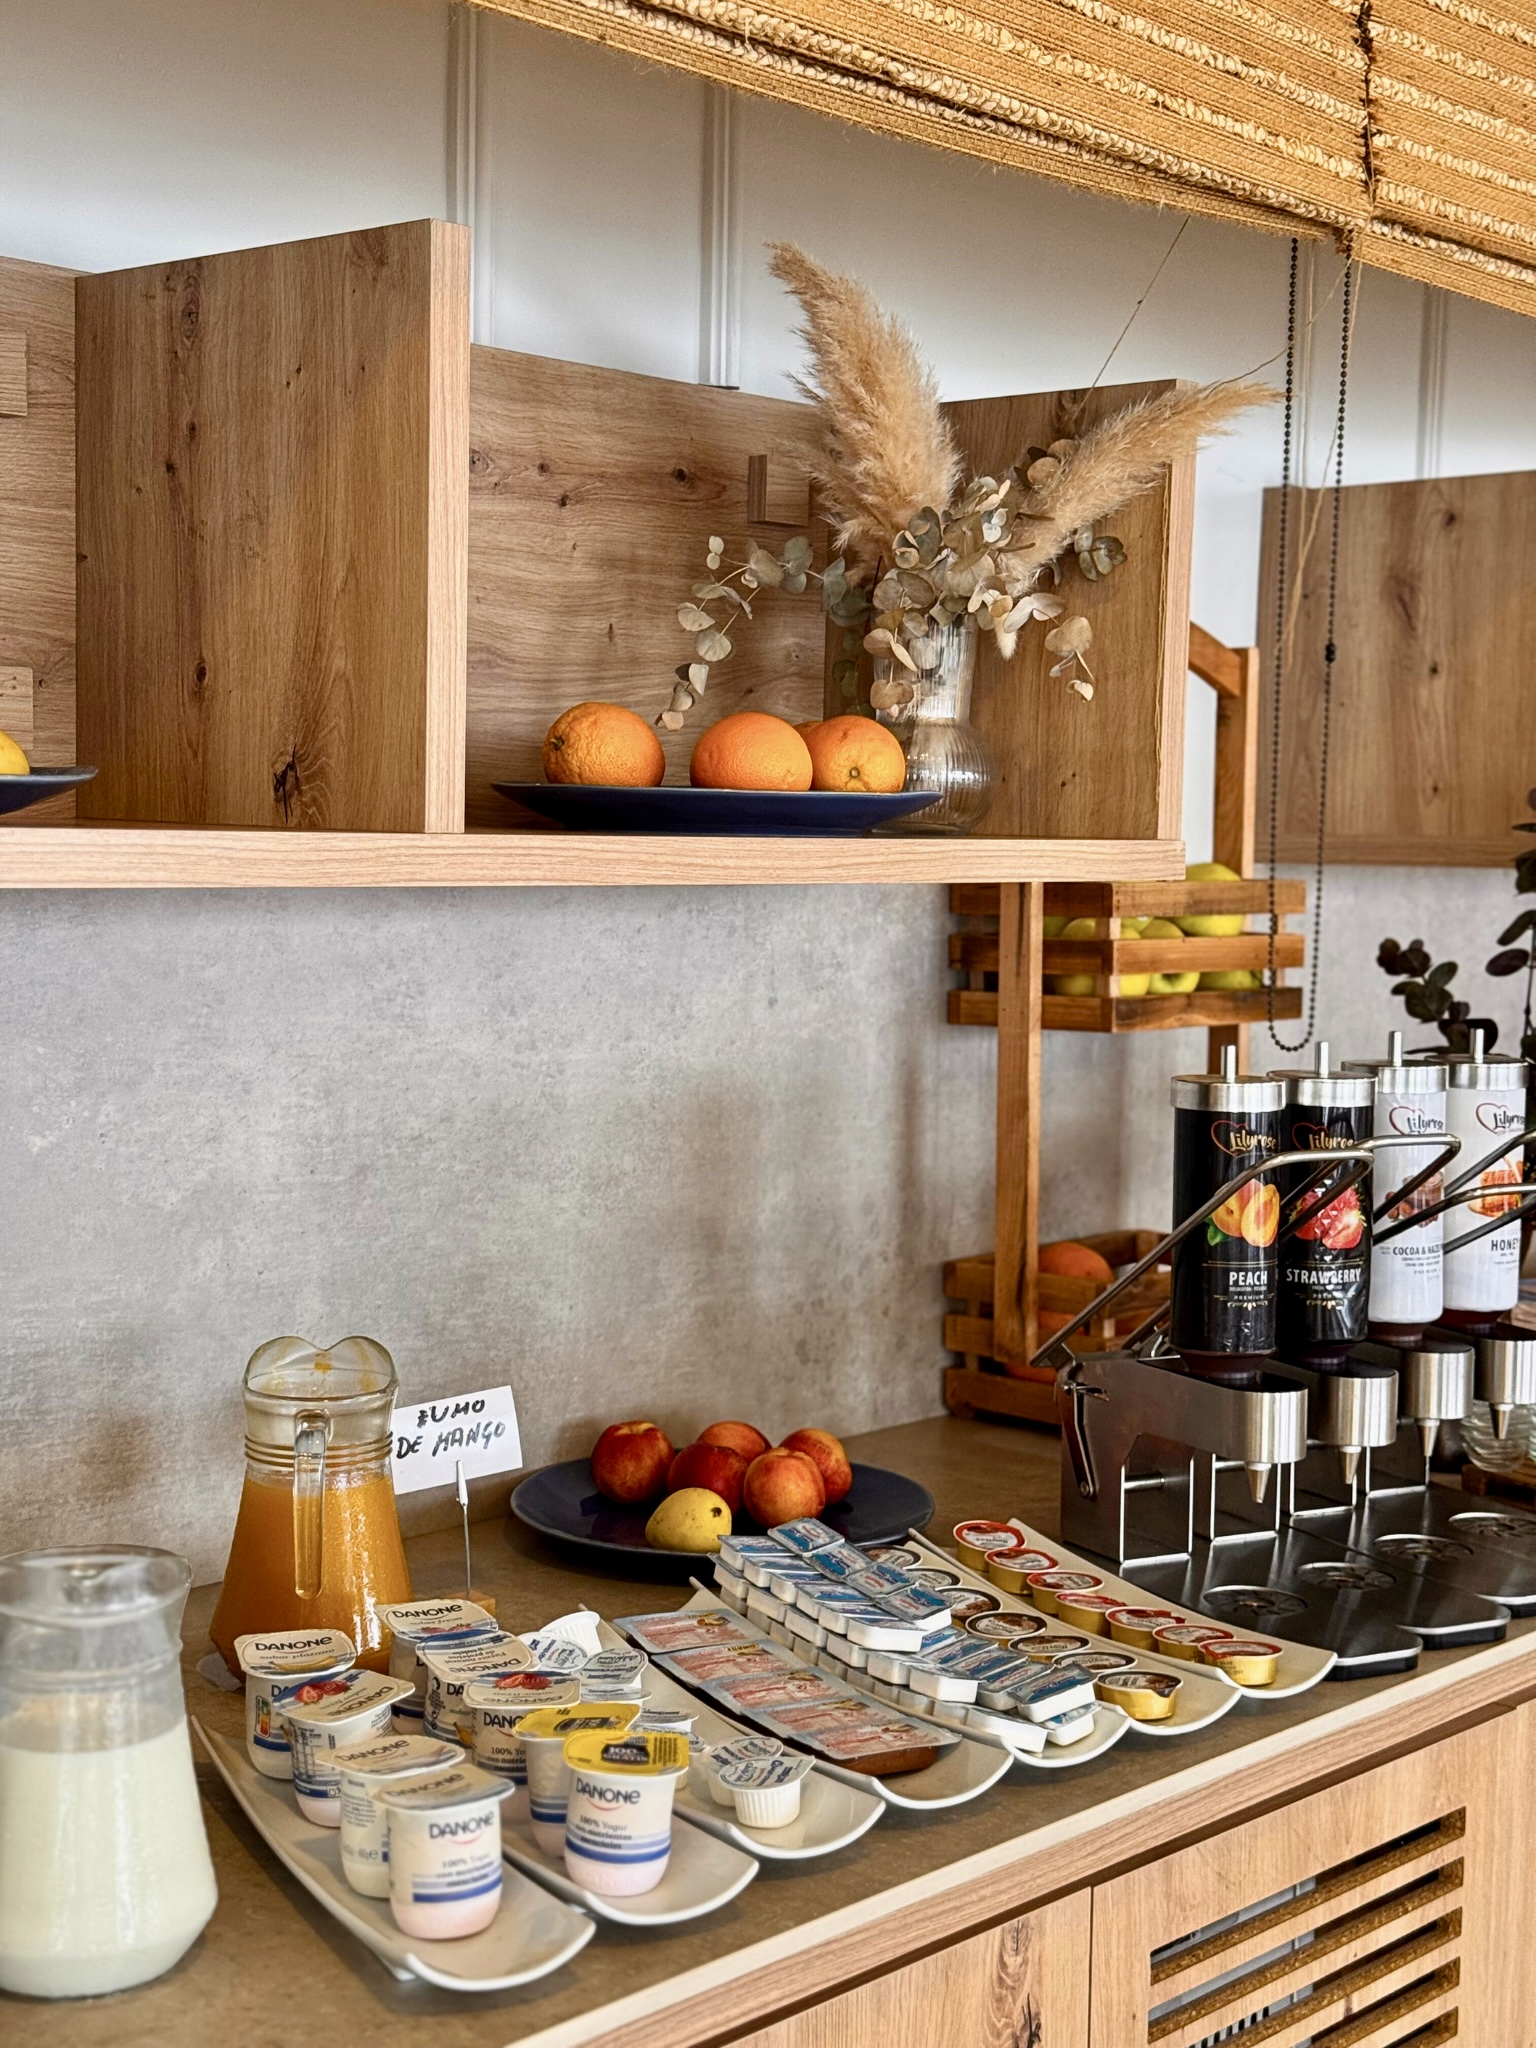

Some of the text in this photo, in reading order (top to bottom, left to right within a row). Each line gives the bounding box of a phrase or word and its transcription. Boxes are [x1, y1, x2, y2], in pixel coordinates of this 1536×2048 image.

[1229, 1129, 1277, 1151] Lilyrose
[1393, 1246, 1420, 1256] COCOA
[1229, 1271, 1268, 1286] PEACH
[396, 1421, 506, 1460] DE MANGO
[484, 1712, 525, 1728] DANO
[491, 1746, 513, 1755] 100%
[580, 1814, 600, 1828] 100%
